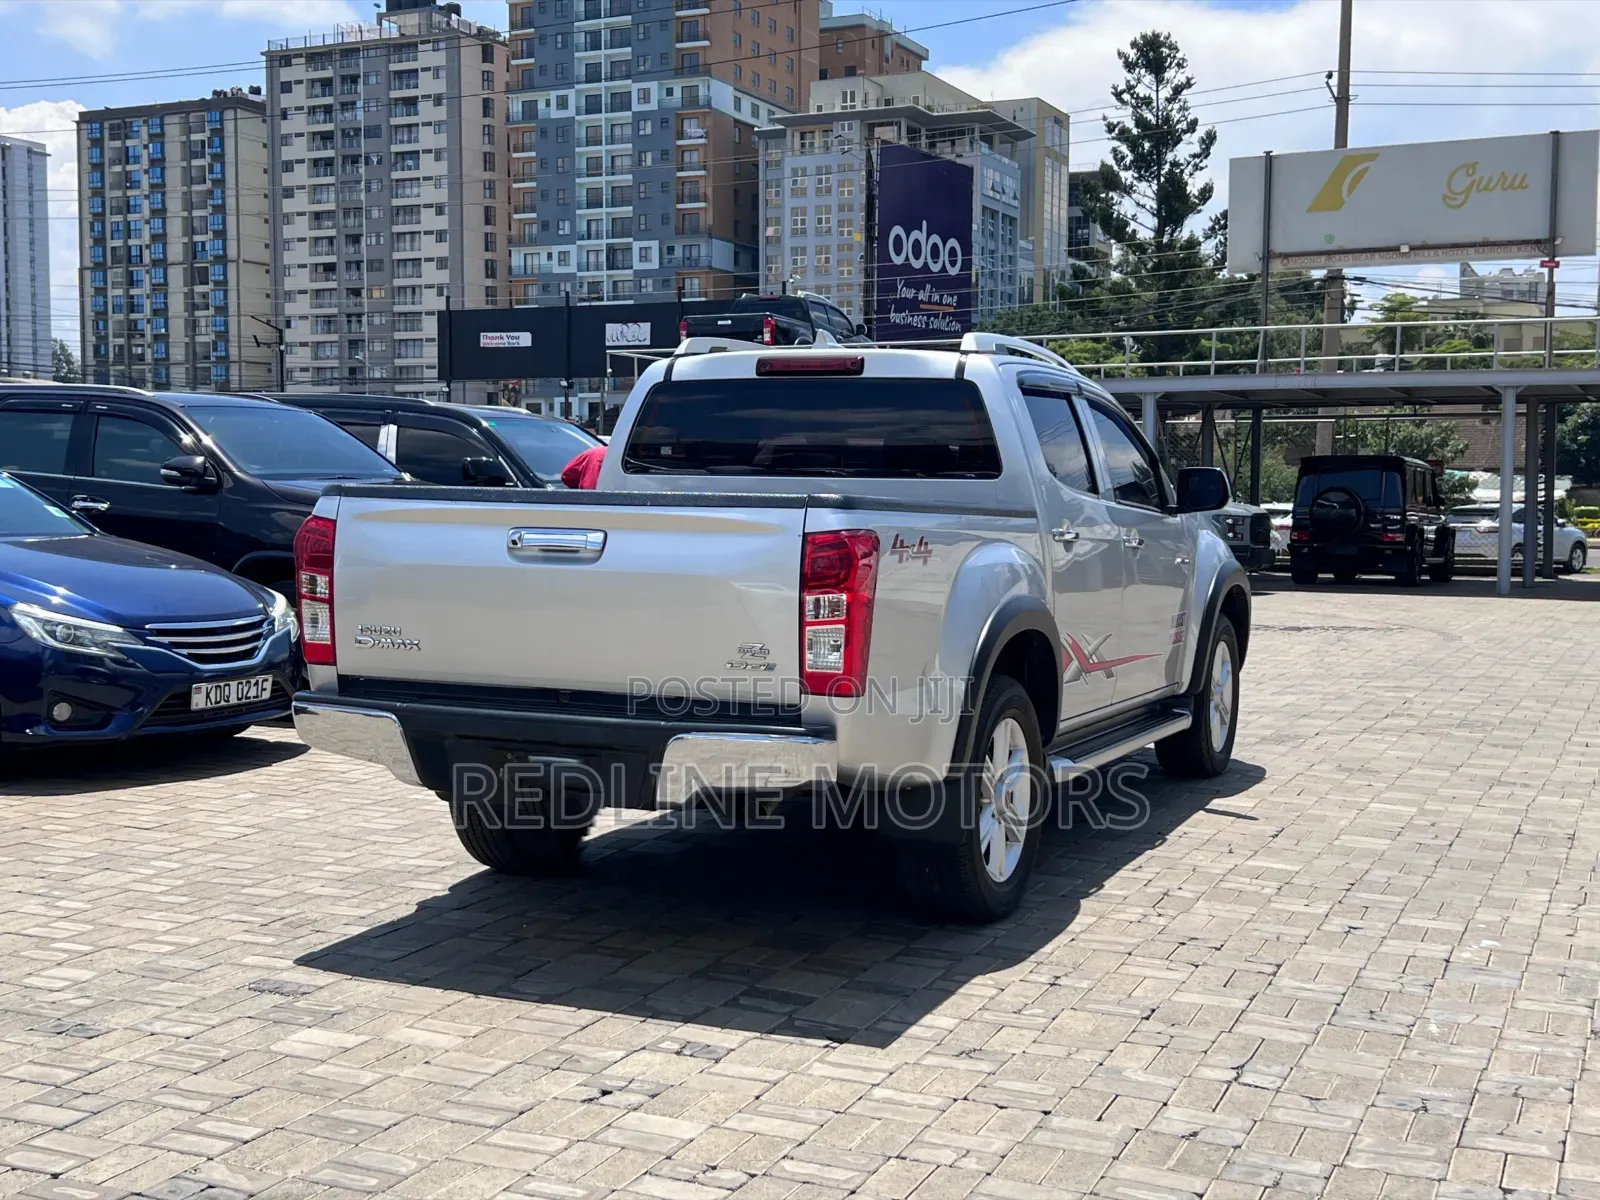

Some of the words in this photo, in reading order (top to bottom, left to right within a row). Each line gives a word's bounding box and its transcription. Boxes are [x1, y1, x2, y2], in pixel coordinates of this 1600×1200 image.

[1442, 161, 1530, 209] Guru
[888, 219, 962, 276] odoo
[1290, 256, 1321, 266] NGONG
[1325, 255, 1349, 264] ROAD
[1351, 253, 1376, 262] NEAR
[1414, 250, 1439, 259] HILLS
[1441, 248, 1472, 257] HOTEL
[896, 277, 917, 300] Your
[942, 294, 958, 306] one
[889, 303, 928, 329] business
[928, 311, 962, 332] solution
[358, 623, 402, 636] ISUZU
[205, 682, 231, 706] KDQ
[236, 678, 269, 702] 021F
